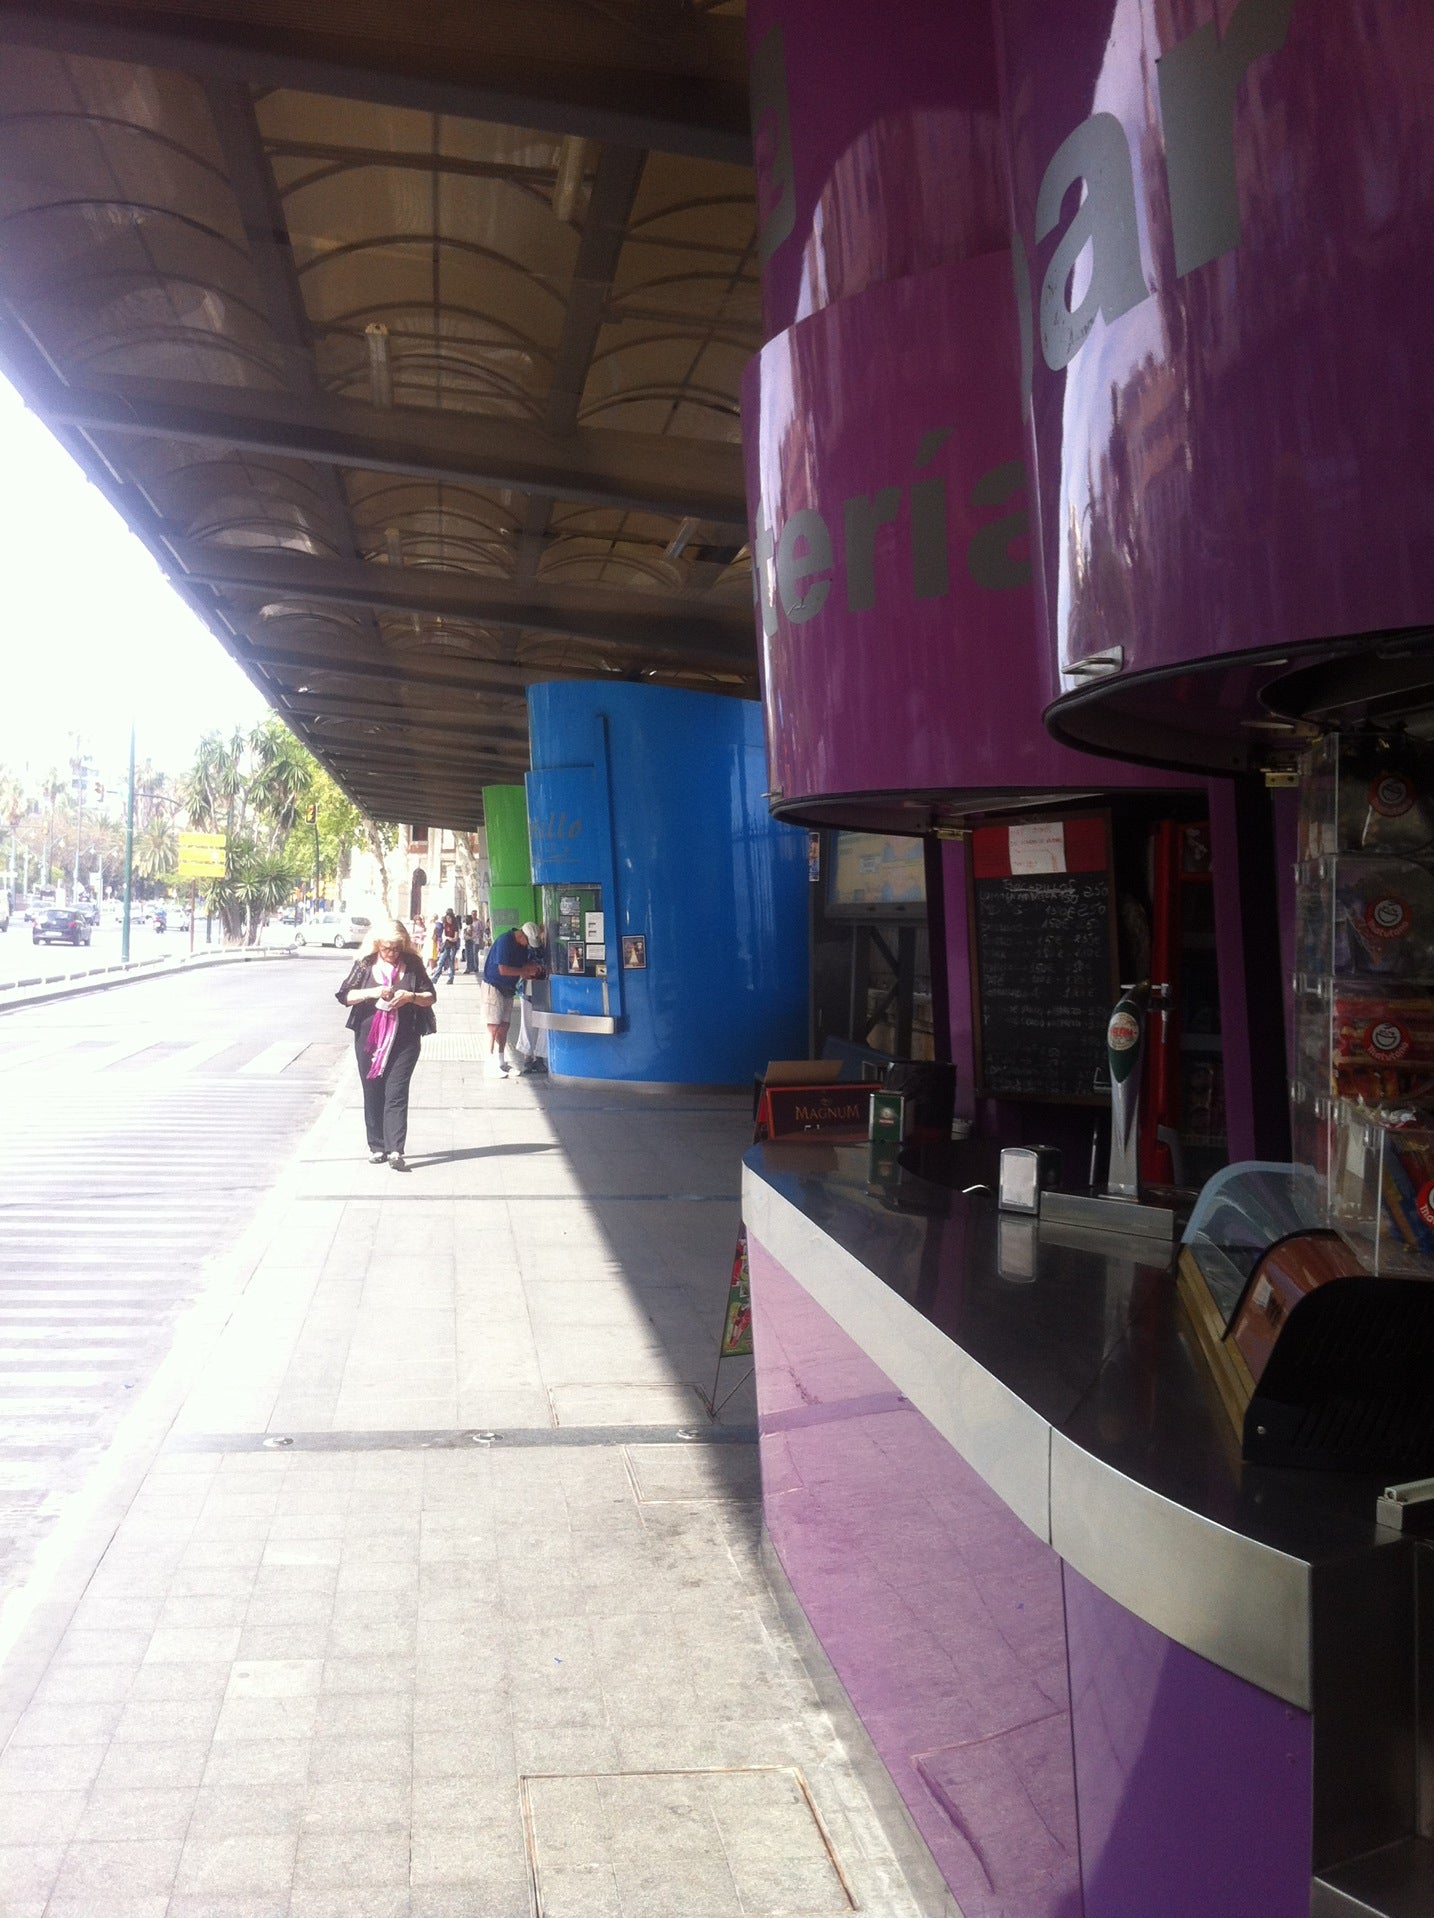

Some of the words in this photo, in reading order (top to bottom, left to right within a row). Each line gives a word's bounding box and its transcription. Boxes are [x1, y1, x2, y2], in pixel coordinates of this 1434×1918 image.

[1011, 0, 1294, 426] ar
[752, 426, 1033, 638] tería
[795, 1104, 861, 1120] MAGNUM
[1419, 1203, 1434, 1226] ma
